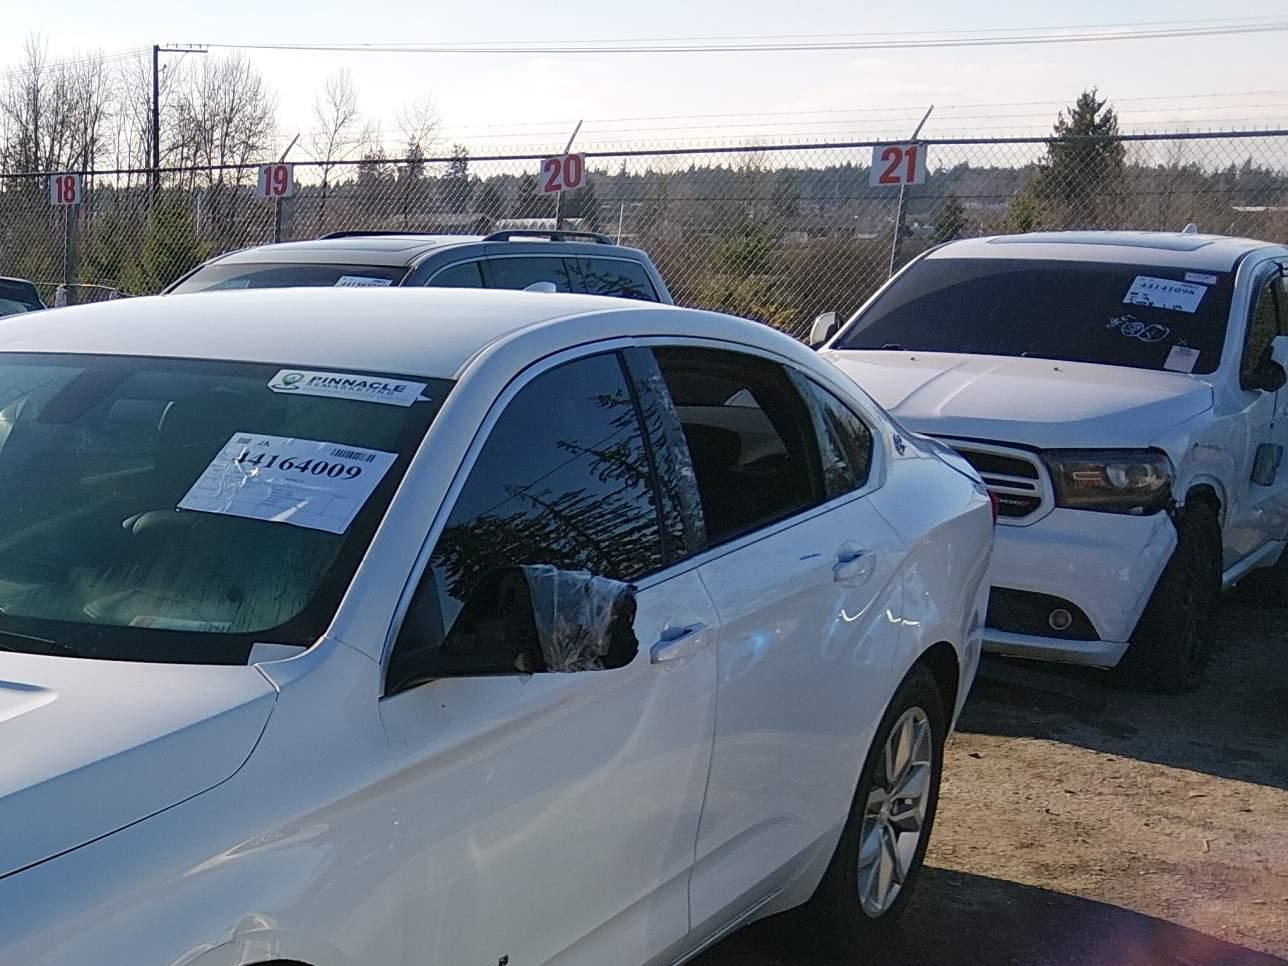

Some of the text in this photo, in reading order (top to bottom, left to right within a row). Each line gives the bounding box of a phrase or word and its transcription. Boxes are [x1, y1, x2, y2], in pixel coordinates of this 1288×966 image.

[263, 165, 288, 196] 19
[544, 154, 582, 192] 20
[879, 147, 917, 184] 21
[55, 175, 76, 203] 18
[308, 376, 407, 392] PINNACLE
[232, 451, 362, 480] 44164009
